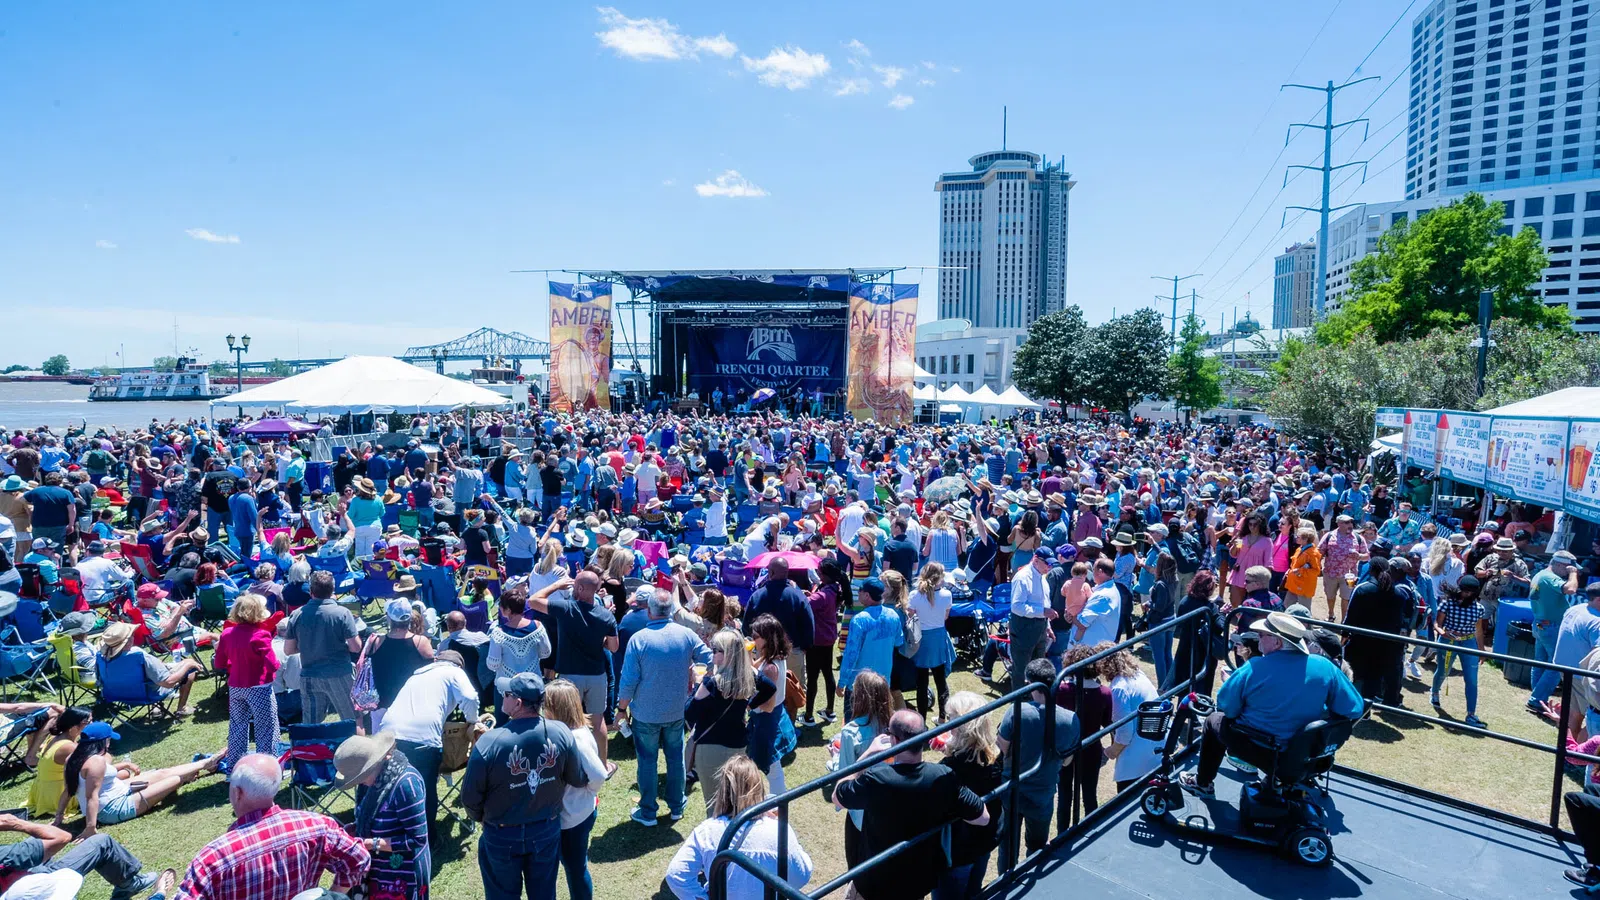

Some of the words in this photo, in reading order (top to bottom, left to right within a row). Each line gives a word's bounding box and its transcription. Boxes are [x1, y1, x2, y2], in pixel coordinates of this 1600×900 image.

[551, 307, 611, 328] AMBER
[851, 309, 916, 333] AMBER
[746, 327, 795, 350] ABITA
[715, 363, 765, 376] FRENCH
[767, 364, 830, 377] QUARTER
[751, 376, 791, 388] FESTIVAL
